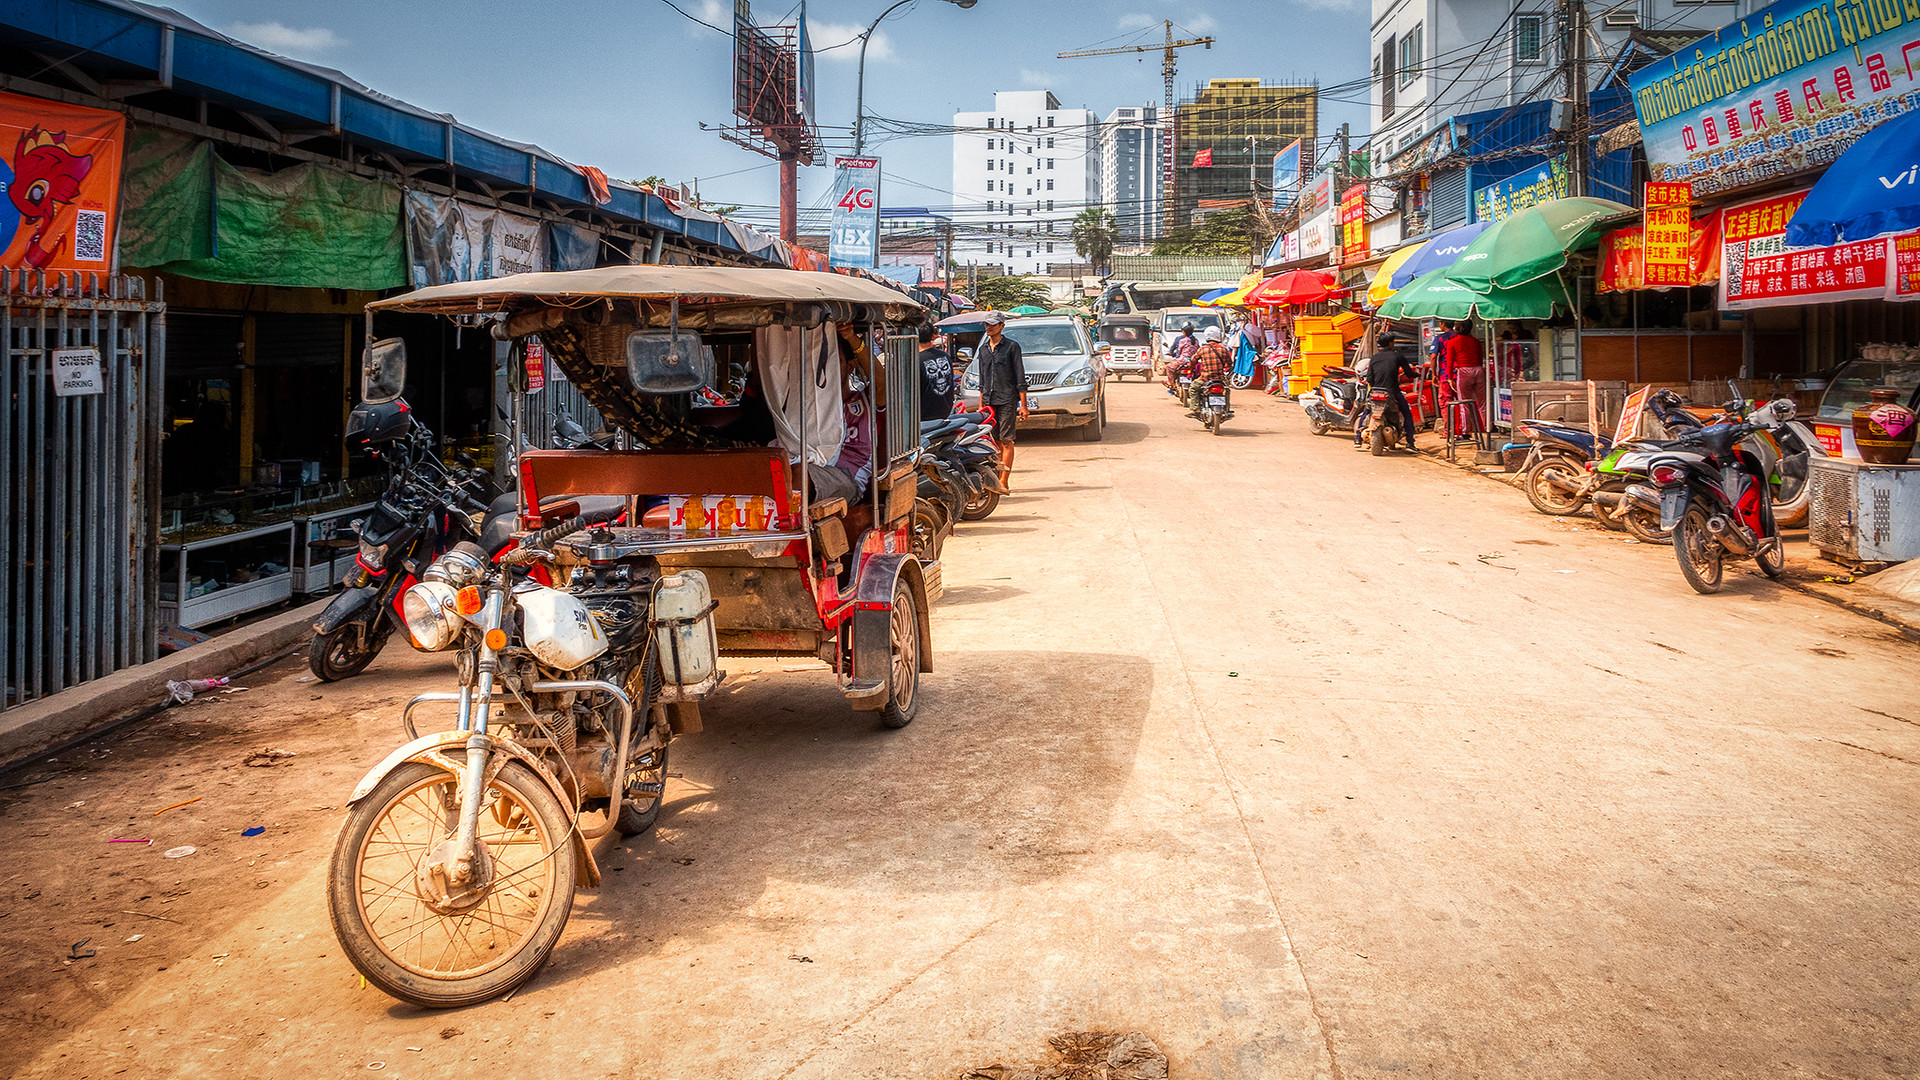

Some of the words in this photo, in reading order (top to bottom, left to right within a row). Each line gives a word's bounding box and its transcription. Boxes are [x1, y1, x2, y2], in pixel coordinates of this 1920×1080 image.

[837, 185, 873, 214] 4G
[1647, 265, 1686, 282] 零售批发
[72, 371, 81, 379] NO
[63, 380, 93, 389] PARKING
